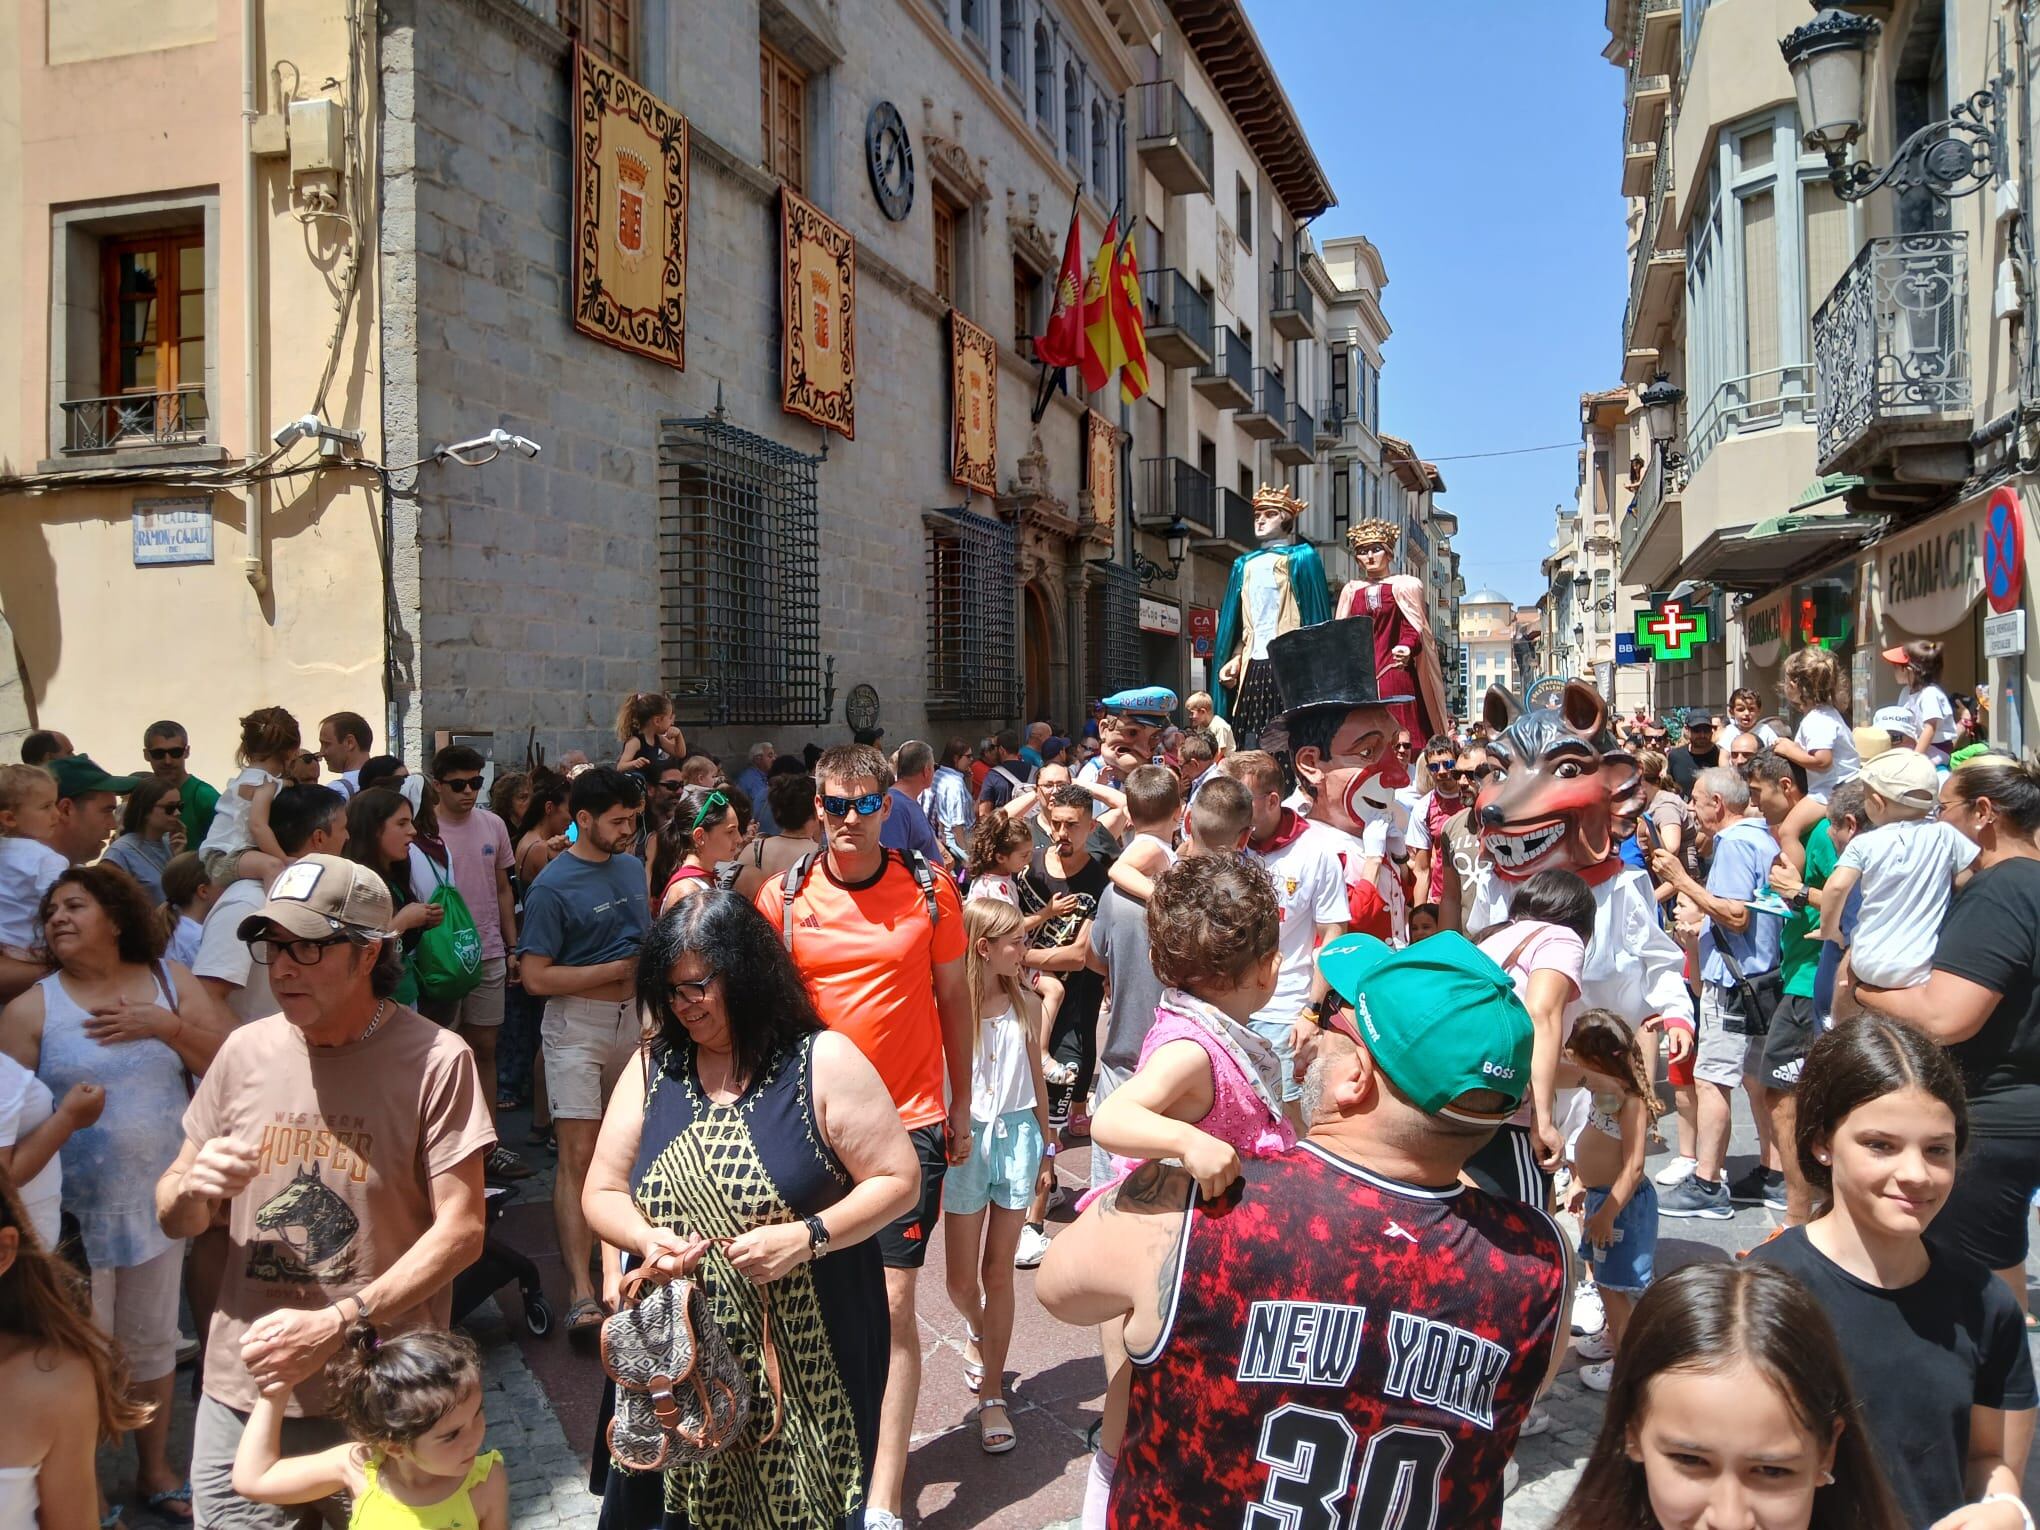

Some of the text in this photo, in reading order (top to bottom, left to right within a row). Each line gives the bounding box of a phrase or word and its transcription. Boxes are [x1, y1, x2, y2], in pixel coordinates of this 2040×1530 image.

[163, 510, 199, 524] CALLE
[176, 527, 208, 545] CAJAL
[1888, 521, 1979, 605] FARMACIA
[1120, 696, 1154, 706] POPEYE
[1358, 992, 1380, 1043] Cognizant
[1482, 1060, 1516, 1080] BOSS
[275, 1111, 365, 1129] WESTERN
[257, 1125, 374, 1183] HORSES
[1236, 1301, 1510, 1431] NEW YORK
[1243, 1402, 1454, 1530] 30
